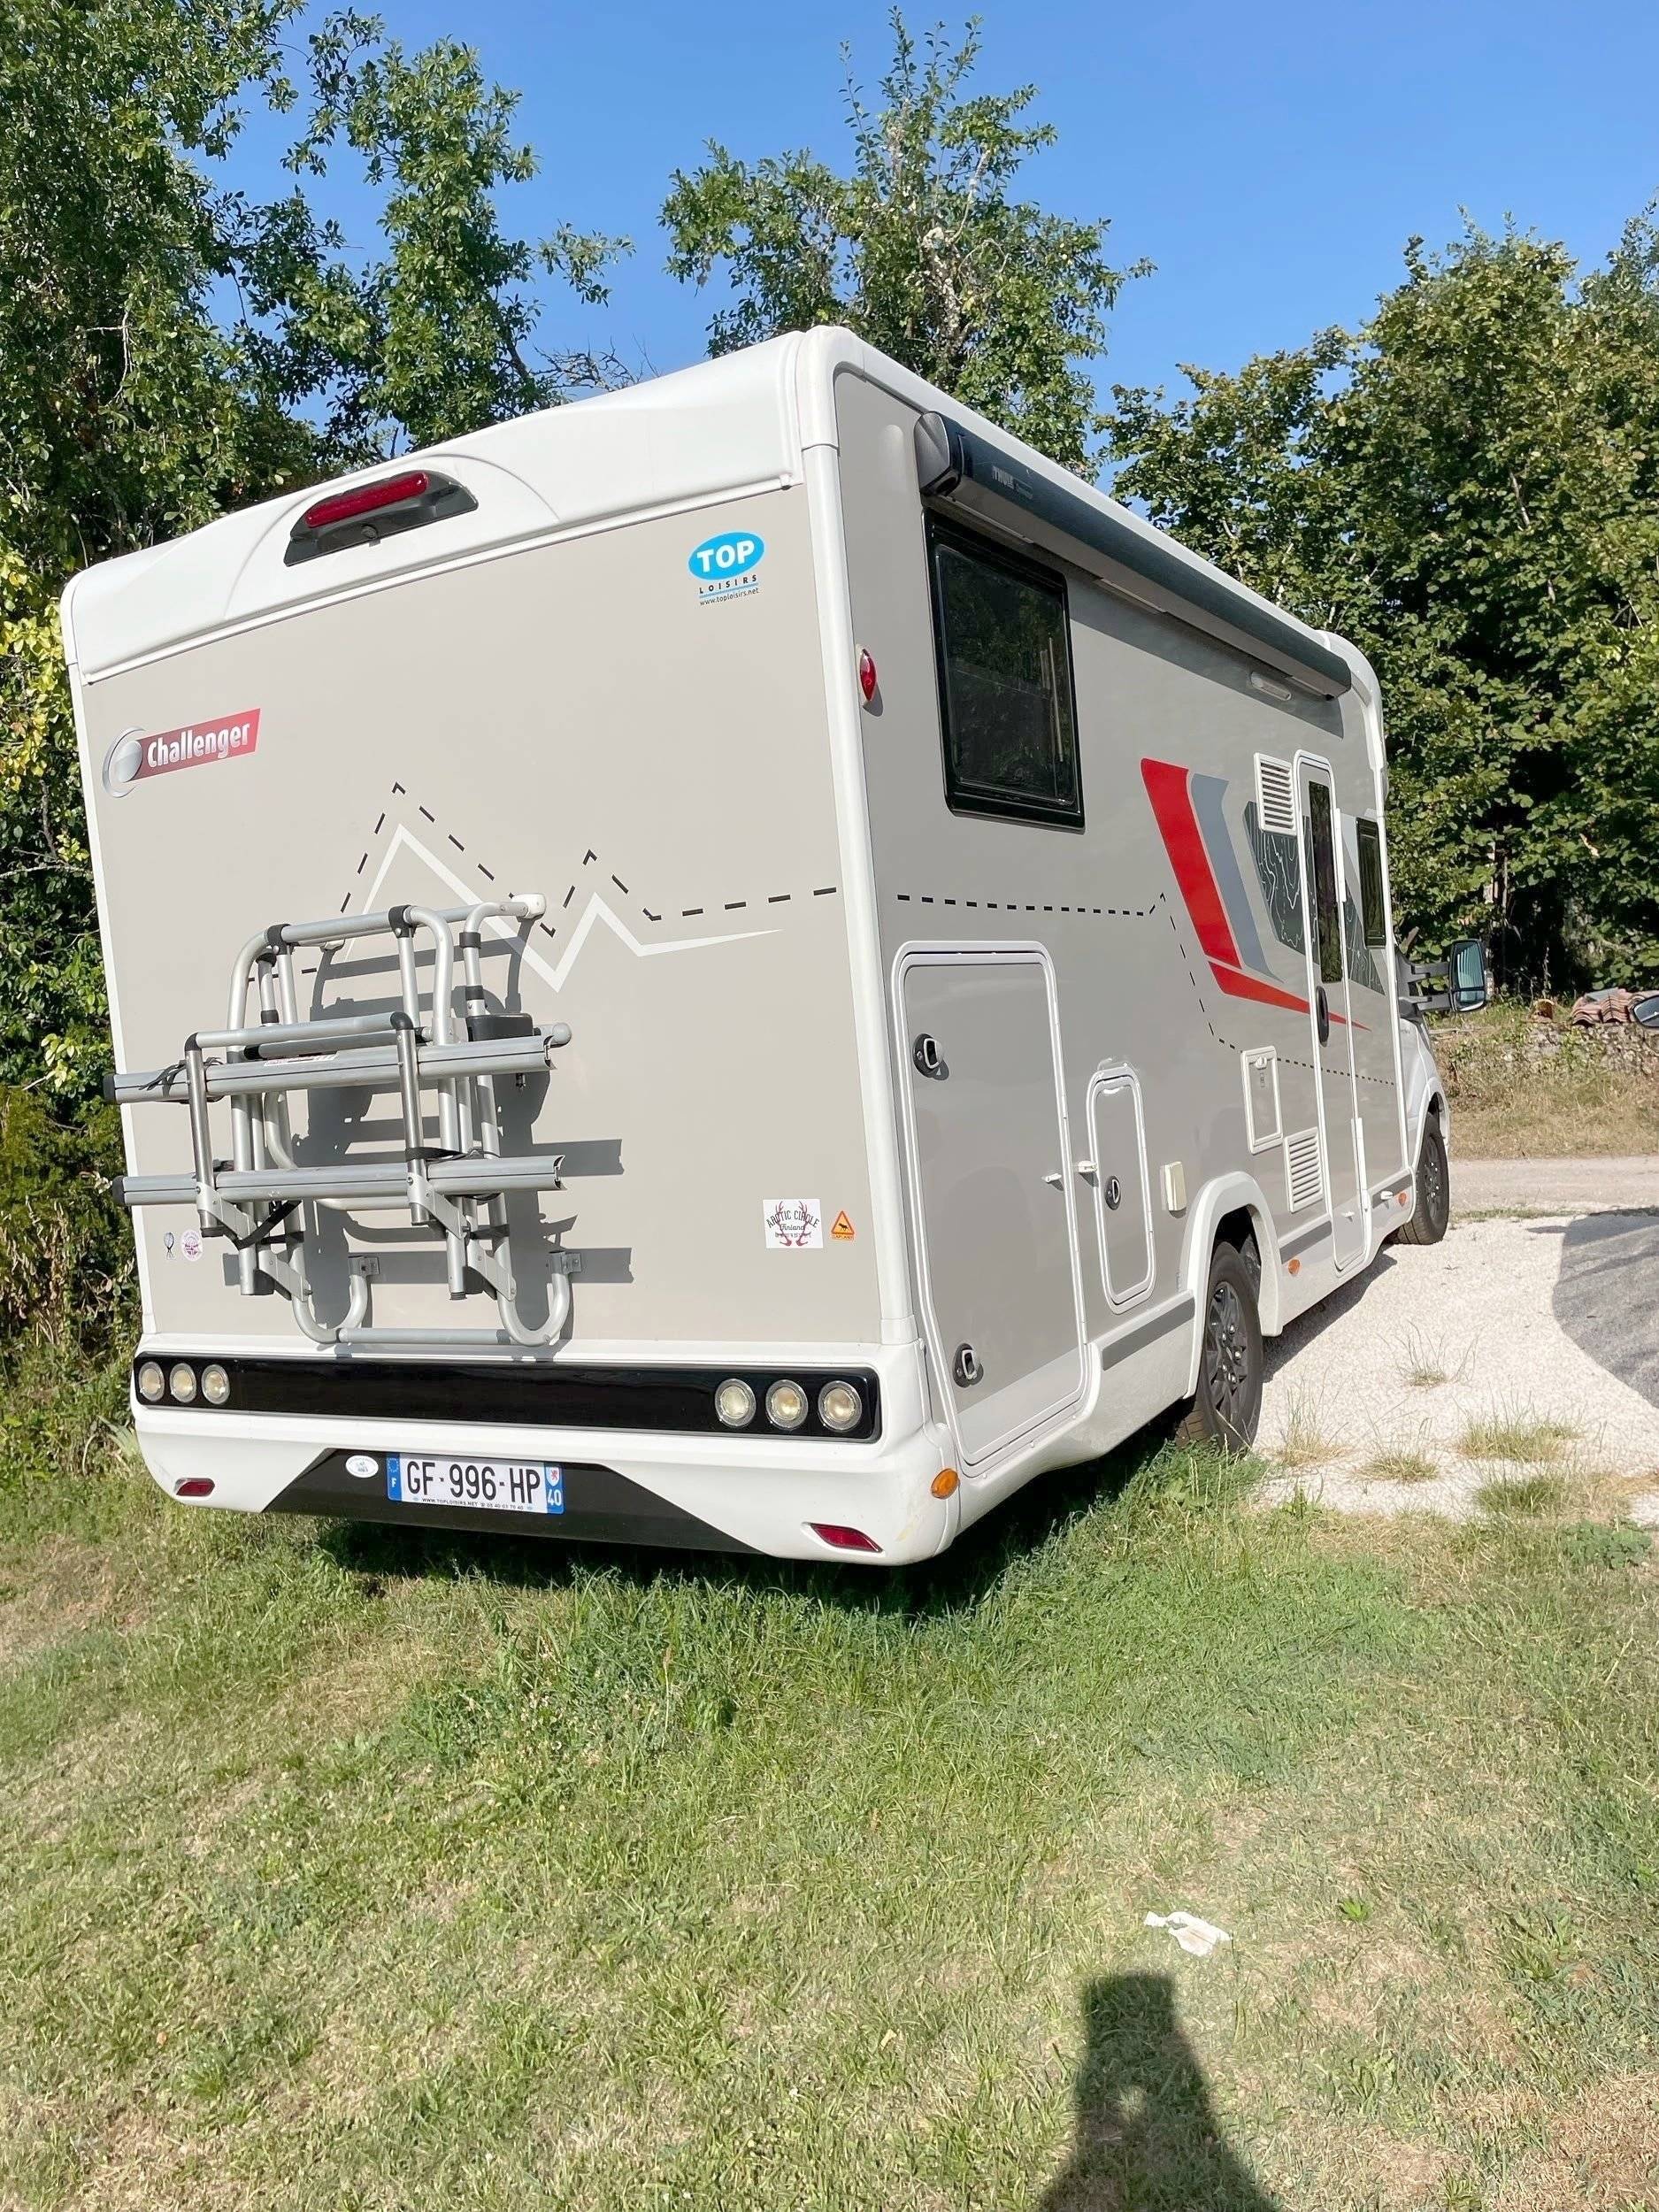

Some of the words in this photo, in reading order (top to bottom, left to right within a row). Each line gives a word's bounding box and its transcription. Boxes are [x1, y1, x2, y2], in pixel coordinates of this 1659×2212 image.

[696, 540, 755, 573] TOP
[699, 574, 757, 595] LOISIRS
[699, 588, 760, 606] www.toploisirs.net
[147, 723, 250, 768] Challenger
[766, 1210, 792, 1228] ARCTIC
[794, 1210, 820, 1228] CIRCLE
[391, 1477, 397, 1488] F
[547, 1489, 563, 1507] 40
